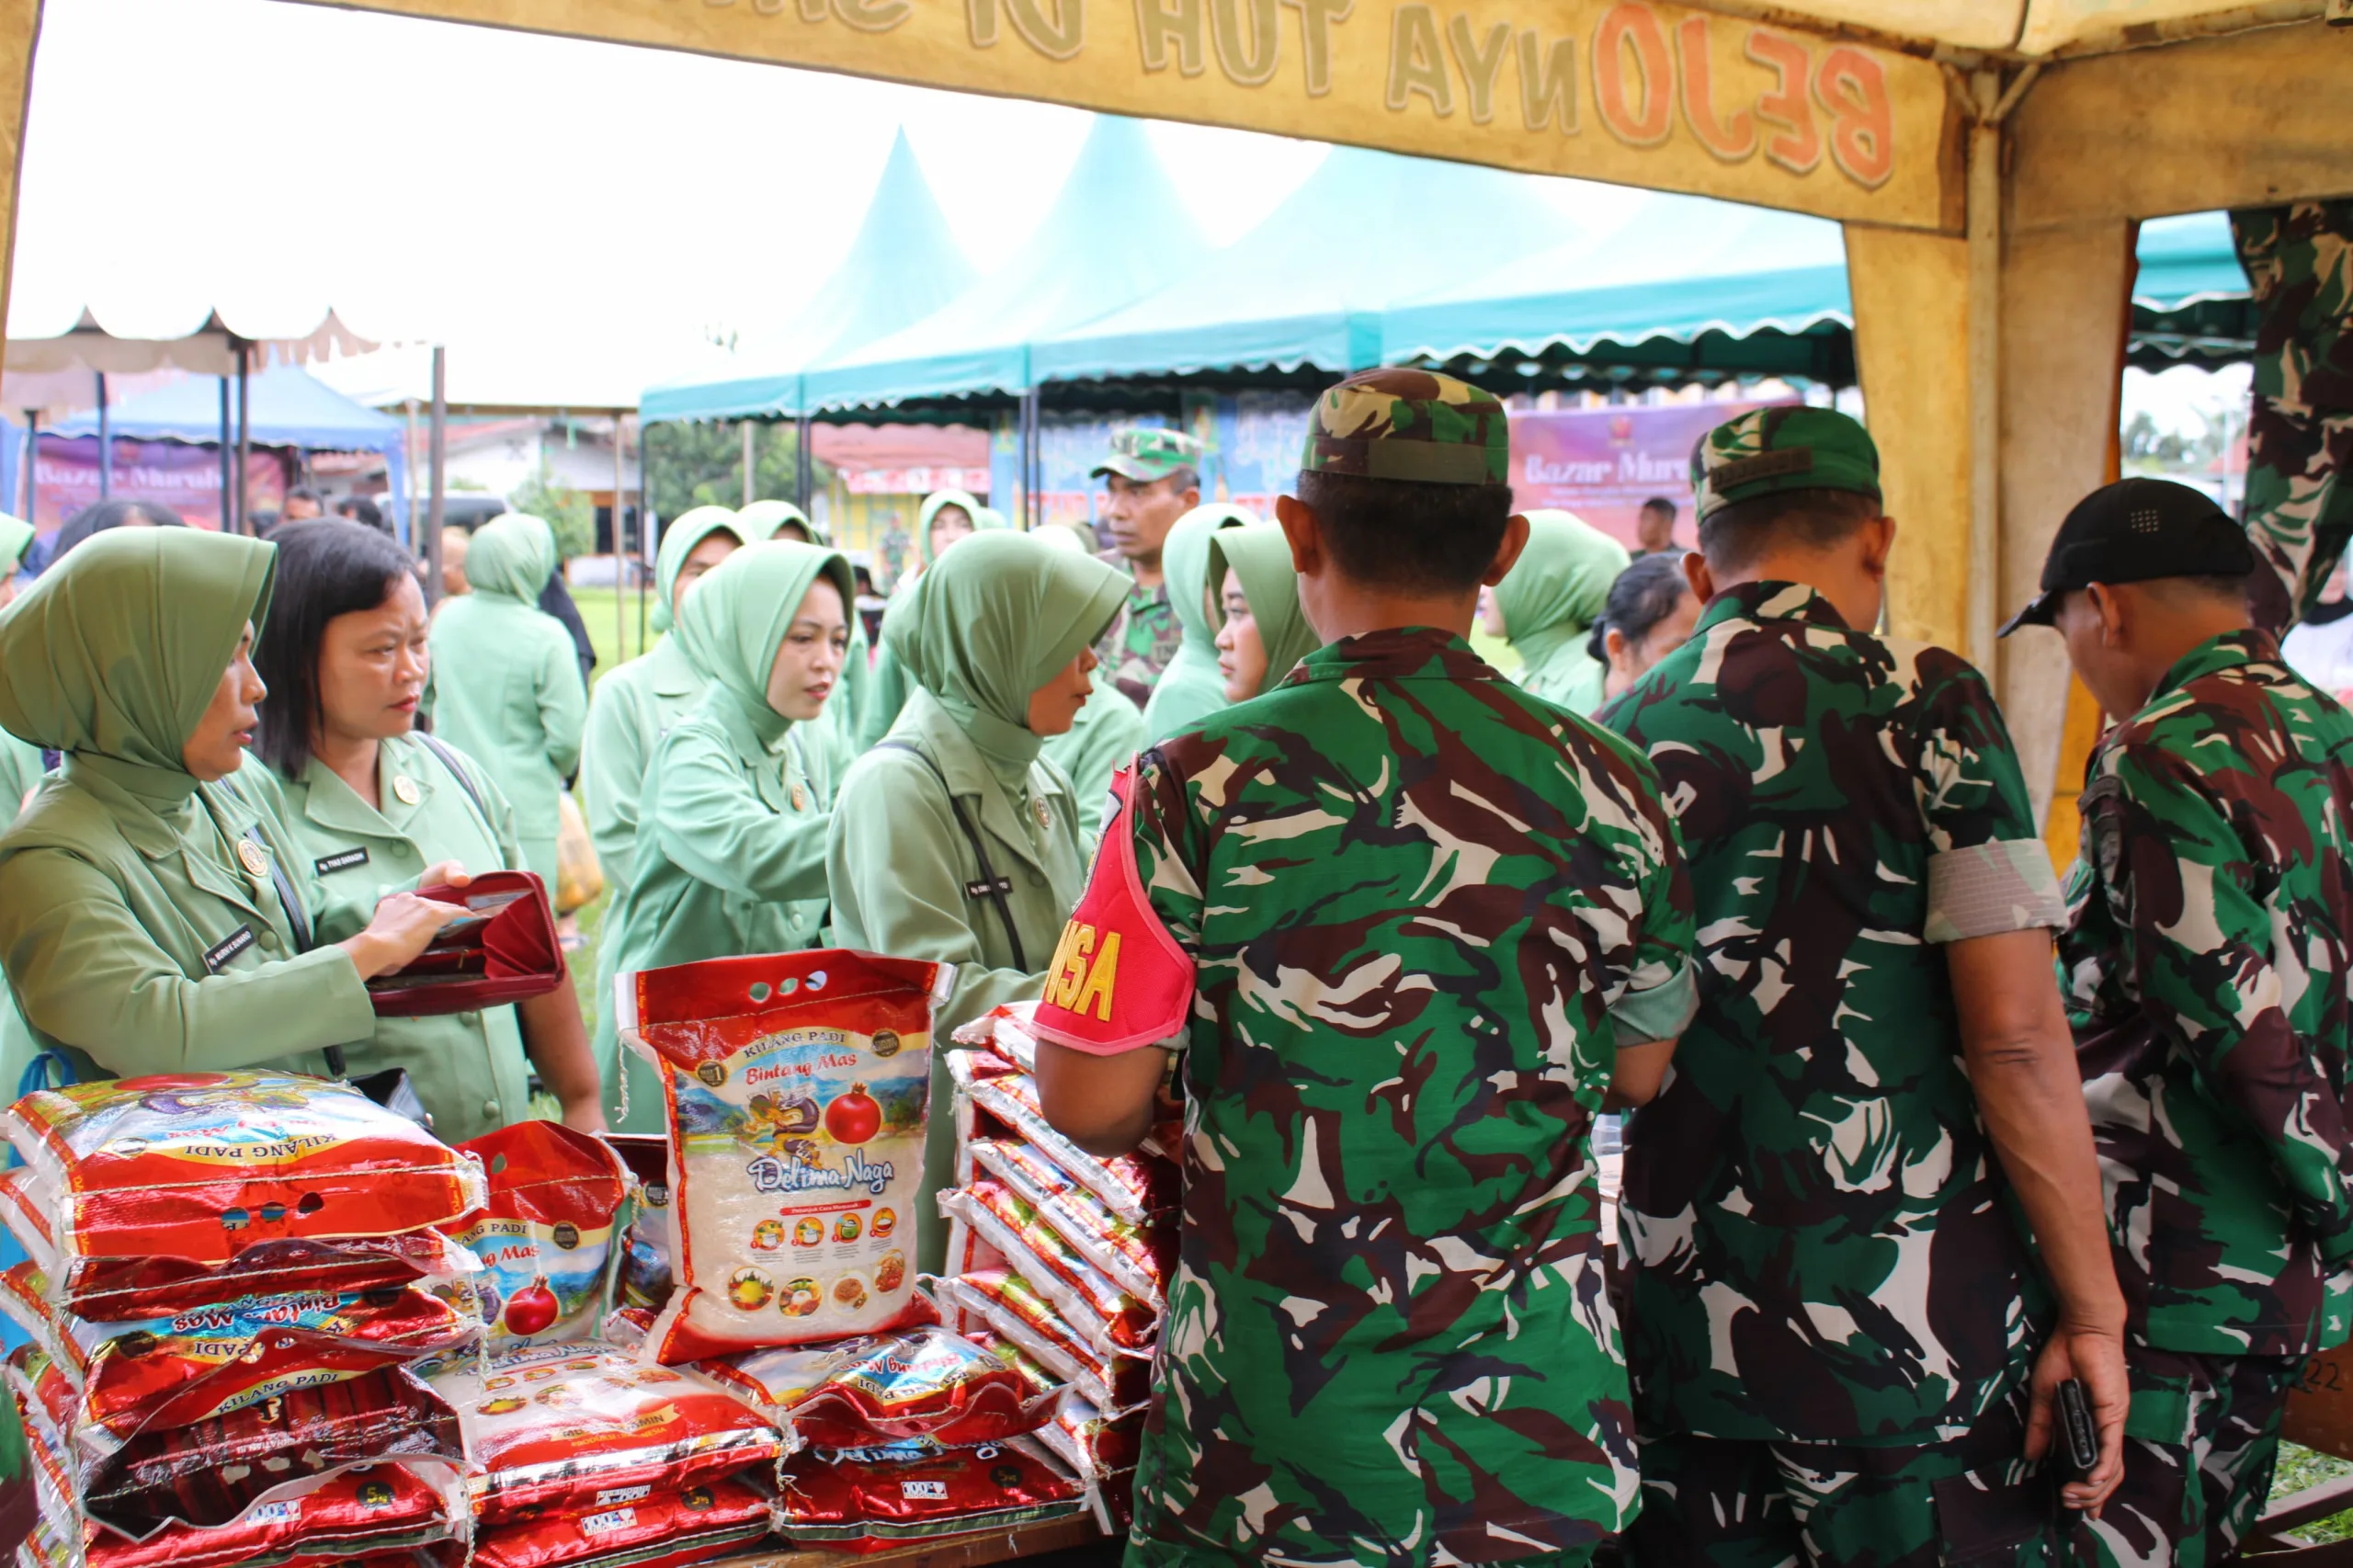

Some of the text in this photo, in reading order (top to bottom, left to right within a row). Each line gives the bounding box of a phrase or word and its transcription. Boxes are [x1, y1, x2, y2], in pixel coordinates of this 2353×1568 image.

[1526, 454, 1611, 484] Bazar
[1618, 451, 1690, 484] Mur
[1041, 919, 1120, 1022] NSA
[744, 1030, 847, 1058] KILANG PADI
[745, 1053, 857, 1085] Bintang Mas
[185, 1132, 340, 1158] KILANG PADI
[747, 1148, 894, 1194] Delima Naga
[490, 1223, 528, 1233] PADI
[501, 1245, 540, 1262] Mas
[173, 1311, 235, 1332] Mas
[218, 1373, 339, 1414] KILANG PADI
[858, 1378, 896, 1401] PADI
